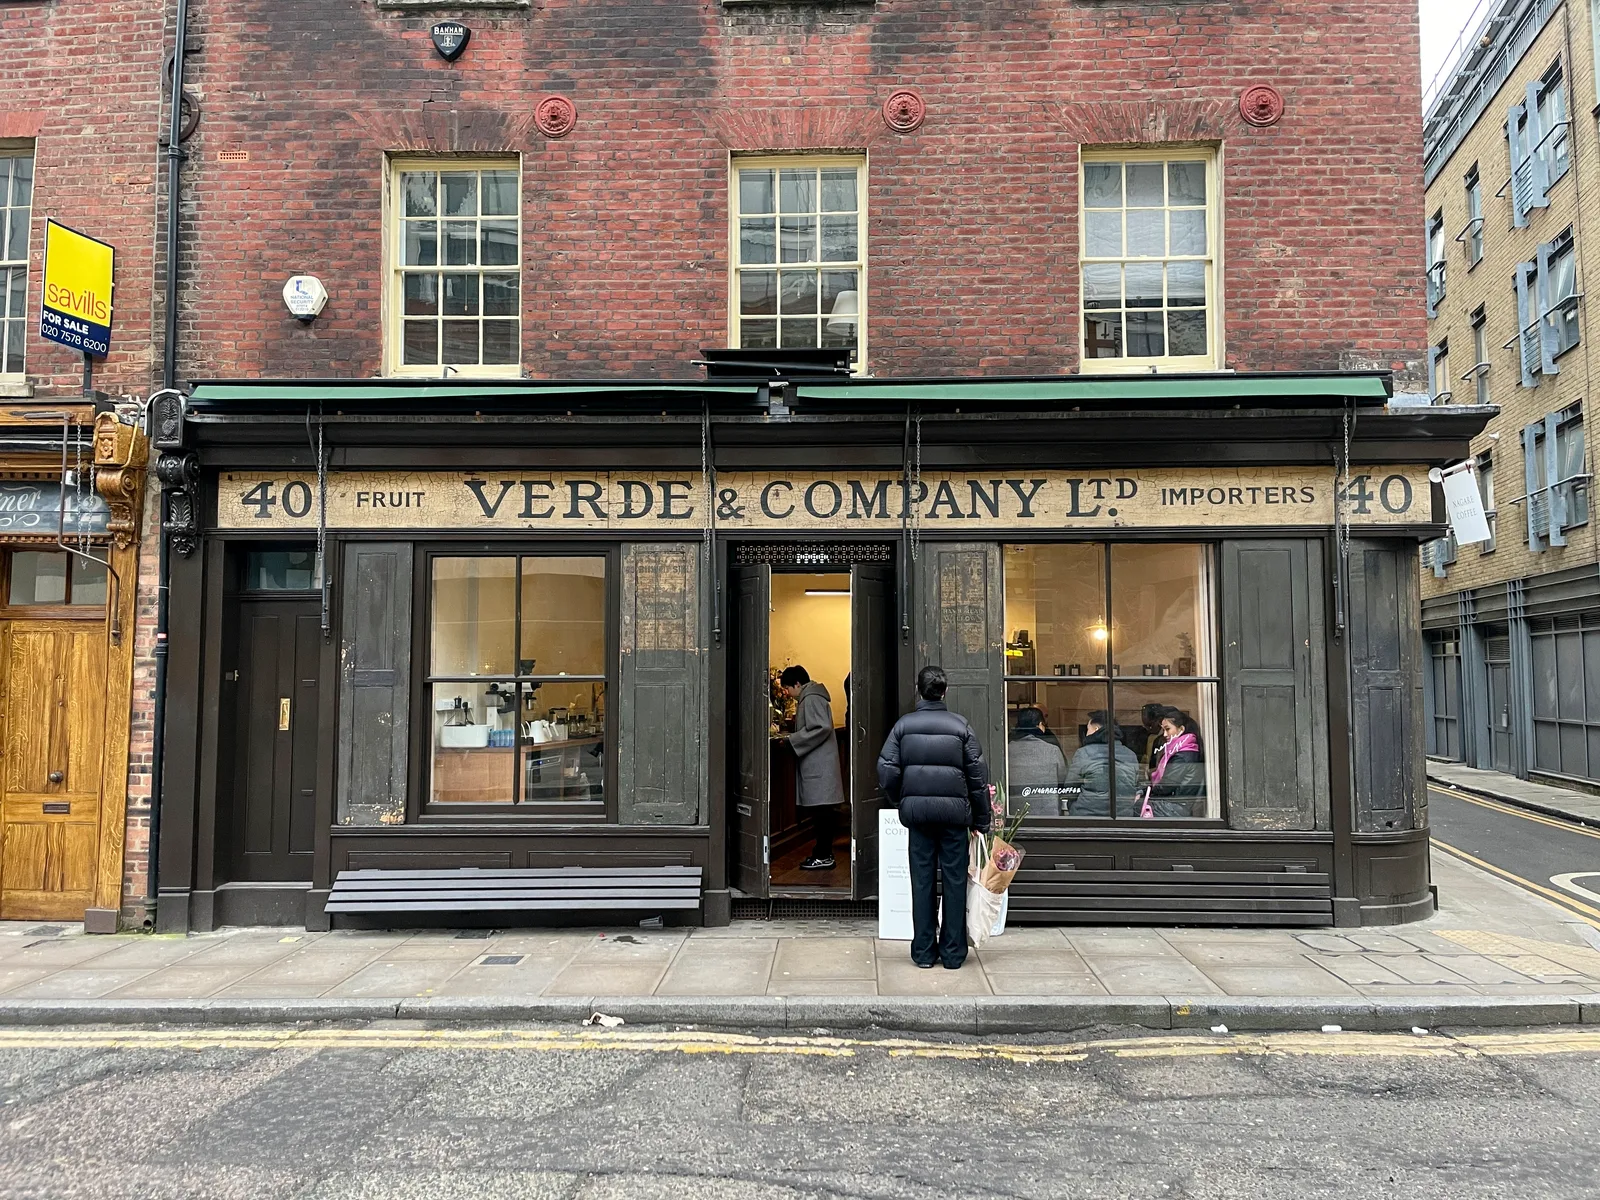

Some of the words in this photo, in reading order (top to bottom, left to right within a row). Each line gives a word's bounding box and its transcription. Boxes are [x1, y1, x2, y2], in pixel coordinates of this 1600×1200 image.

[434, 26, 464, 35] BANHAM
[48, 283, 107, 320] savills
[43, 310, 62, 326] FOR
[63, 318, 89, 335] SALE
[42, 323, 59, 337] 020
[60, 330, 82, 345] 7578
[83, 337, 107, 353] 6200
[241, 480, 313, 519] 40
[356, 491, 426, 508] FRUIT
[464, 480, 695, 519] VERDE
[716, 488, 745, 520] &
[760, 479, 1048, 519] COMPANY
[1161, 486, 1315, 506] IMPORTERS
[1338, 474, 1413, 514] 40
[1452, 496, 1475, 509] NAGARE
[1456, 508, 1478, 520] COFFEE
